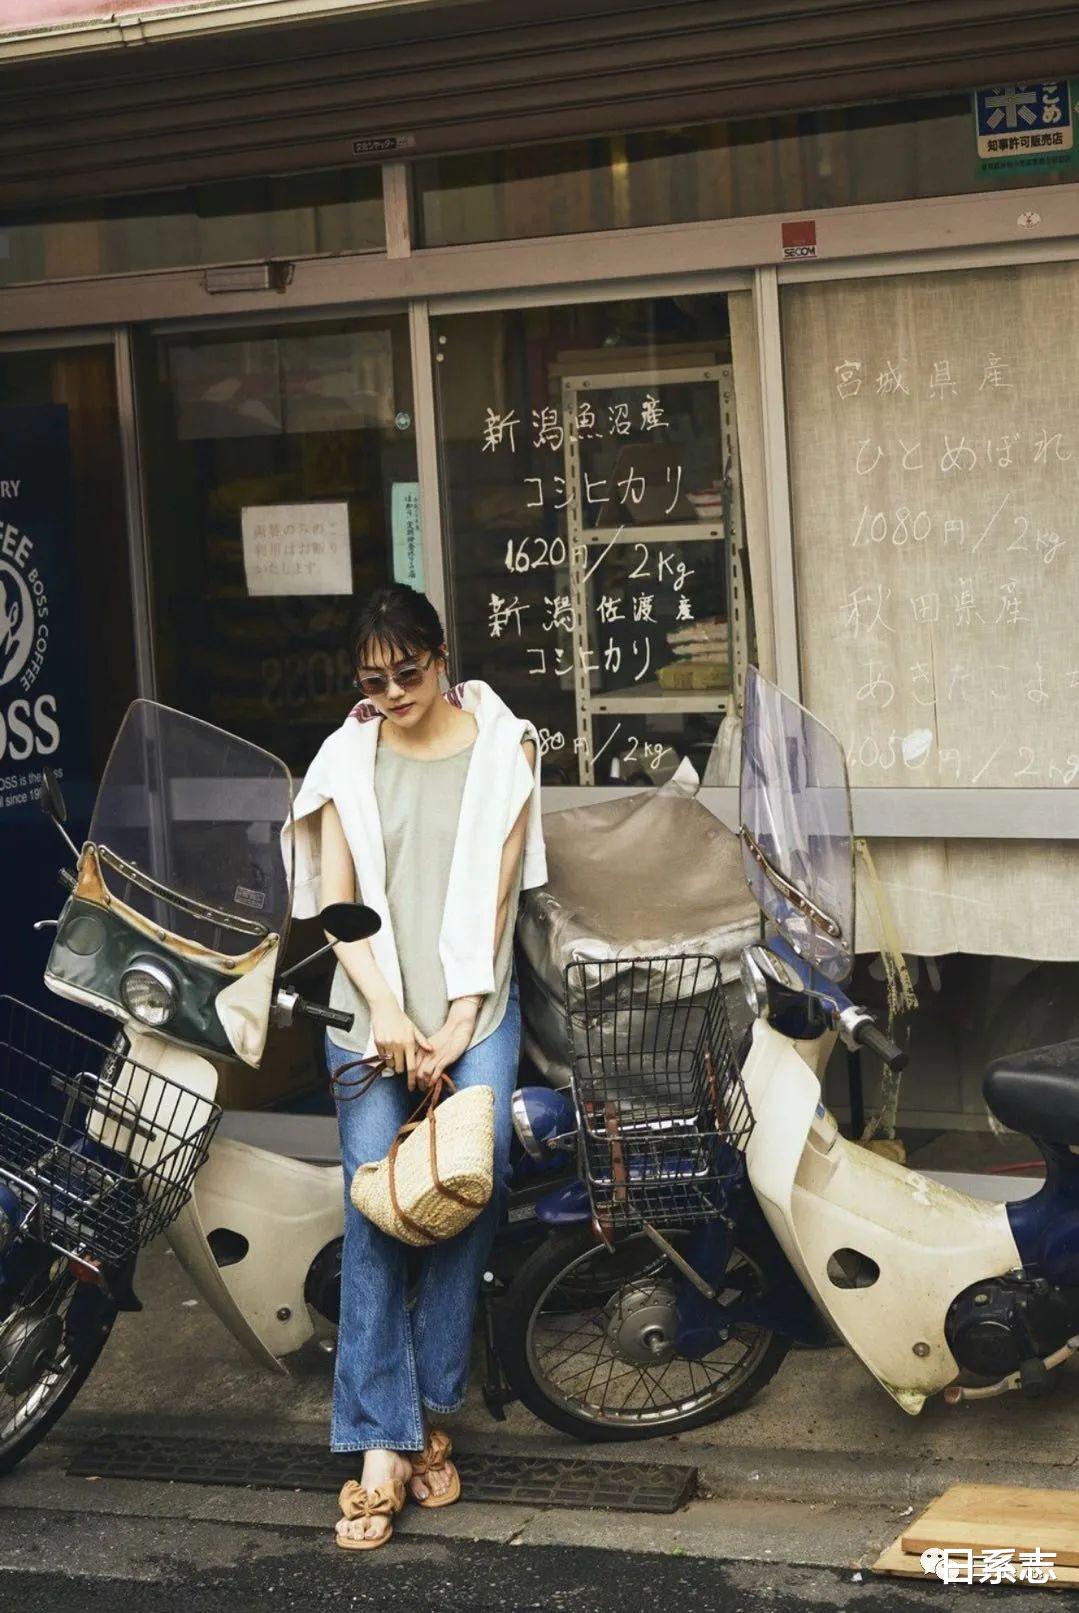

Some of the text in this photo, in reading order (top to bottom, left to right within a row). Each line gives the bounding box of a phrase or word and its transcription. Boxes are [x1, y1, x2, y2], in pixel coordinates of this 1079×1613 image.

[783, 247, 816, 257] SECOM
[834, 352, 1014, 400] 宮城県産
[481, 393, 669, 452] 新潟魚沼産
[855, 428, 1073, 475] ひとめぼれ
[523, 465, 683, 514] コシヒカリ
[0, 522, 34, 568] EE
[19, 567, 48, 692] BOSS COFFEE
[488, 592, 695, 638] 新潟佐渡産
[840, 577, 1030, 638] 秋田県産
[526, 637, 650, 681] コシヒカリ
[5, 792, 28, 807] since
